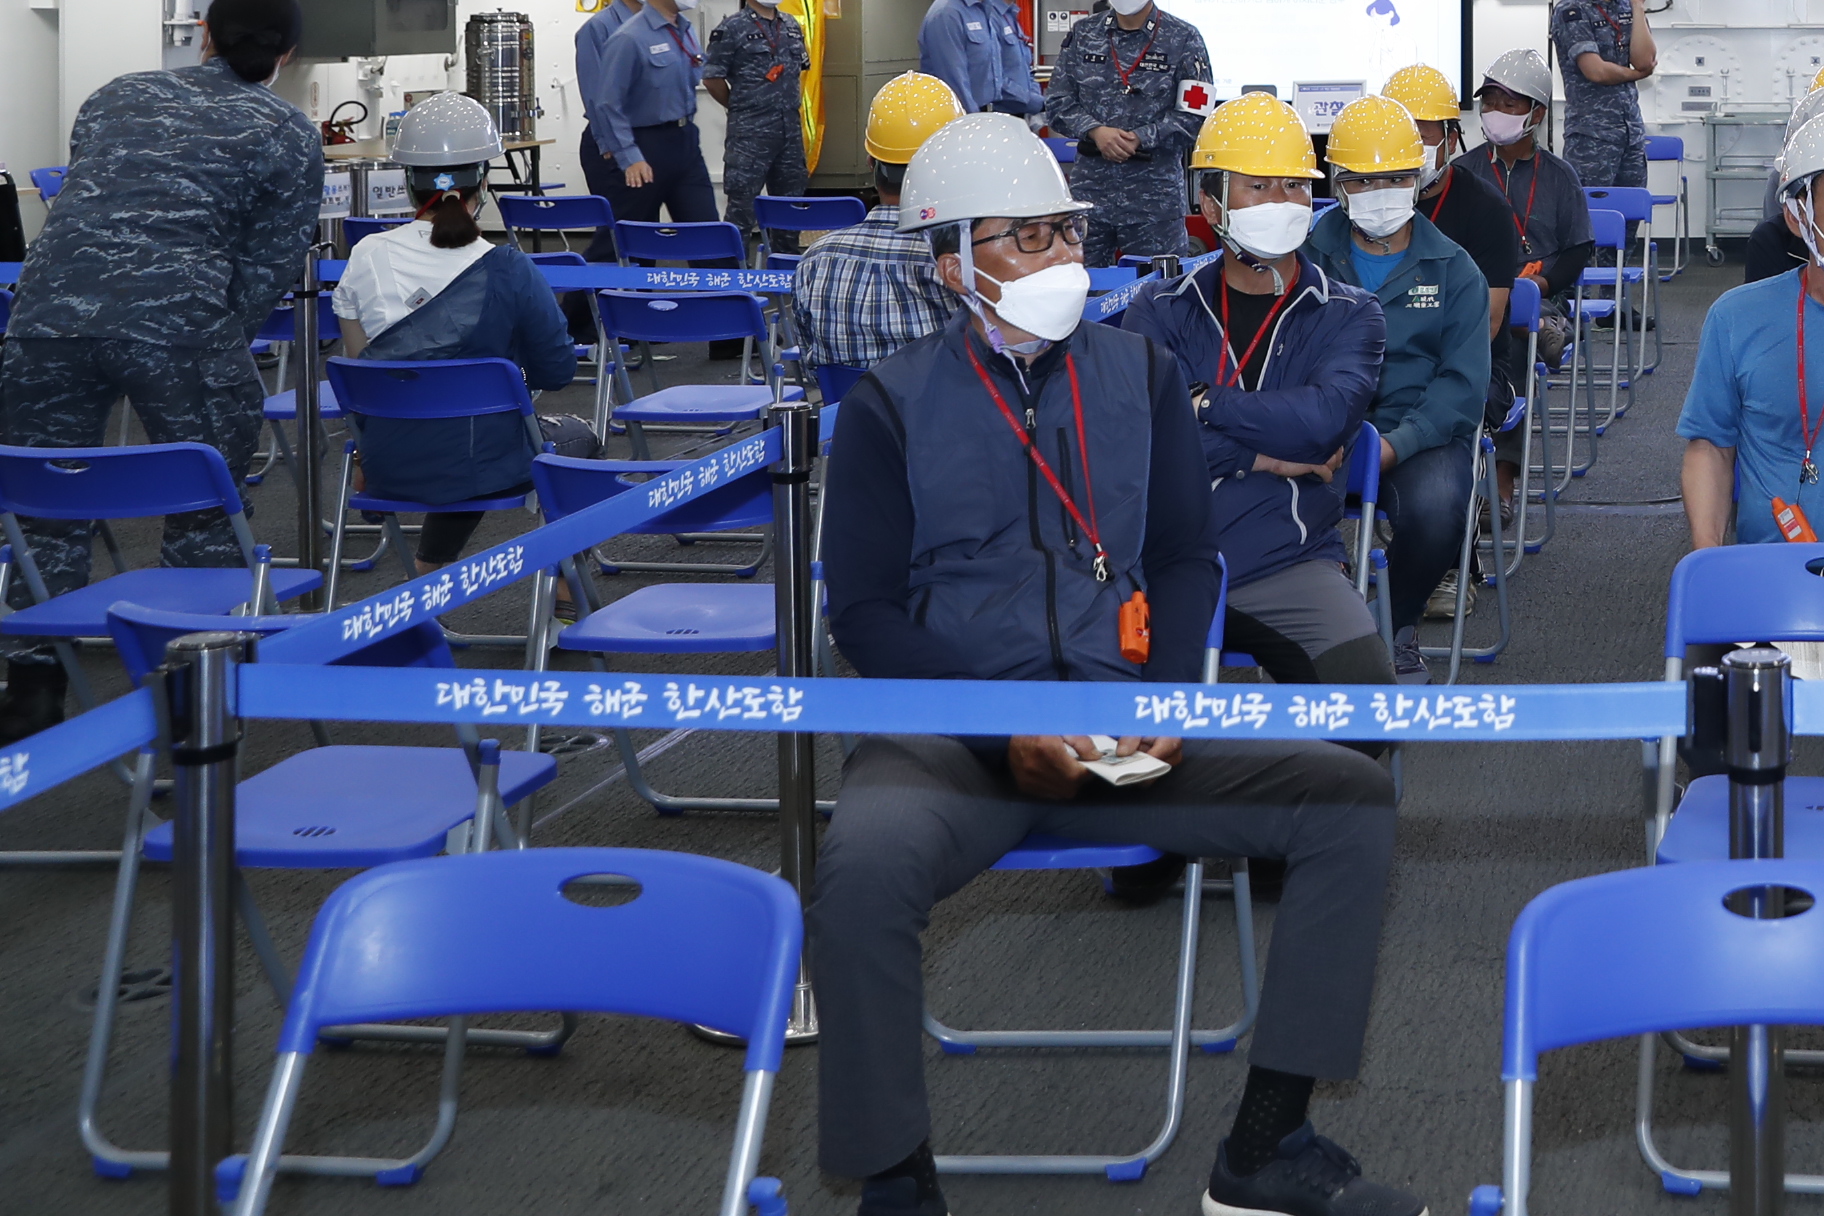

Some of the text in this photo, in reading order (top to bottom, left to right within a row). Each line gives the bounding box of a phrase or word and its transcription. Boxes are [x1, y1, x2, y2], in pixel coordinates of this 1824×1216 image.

[646, 271, 700, 287] 대한민국
[706, 273, 732, 287] 해군
[648, 439, 766, 508] 대한민국 해군 한산도함
[342, 544, 524, 641] 대한민국 해군 한산도함
[435, 677, 804, 723] 대한민국 해군 한산도함
[1133, 690, 1517, 733] 대한민국 해군 한산도함
